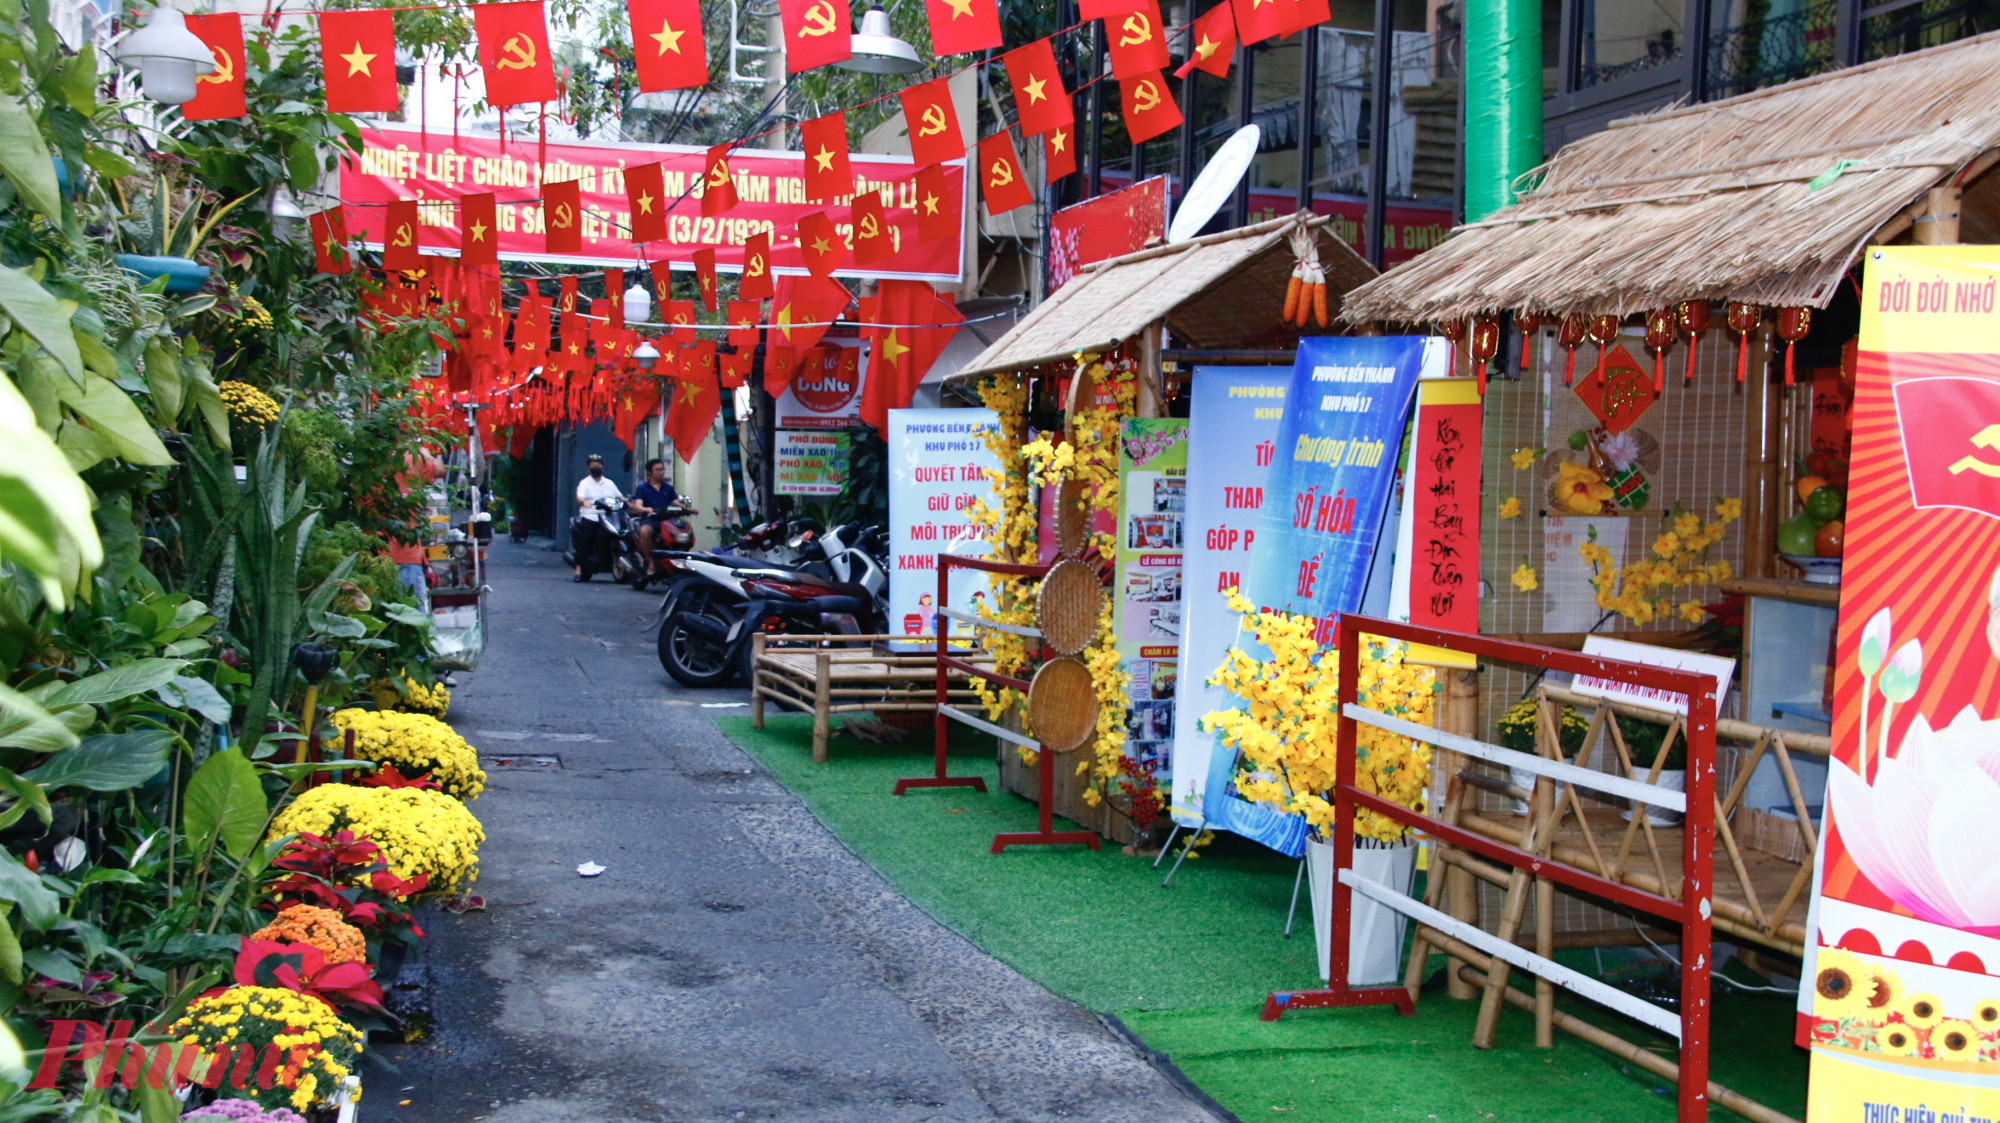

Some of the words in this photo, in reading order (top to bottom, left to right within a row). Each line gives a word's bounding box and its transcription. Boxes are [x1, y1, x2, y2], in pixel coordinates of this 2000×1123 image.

[360, 144, 420, 184] NHIỆT
[426, 148, 467, 188] LIỆT
[473, 153, 528, 187] CHÀO
[1879, 273, 1911, 313] ĐỜI
[1917, 273, 1949, 313] ĐỜI
[1954, 274, 1997, 314] NHỚ
[1229, 384, 1285, 399] PHƯỜNG
[1320, 395, 1341, 411] KHU
[1254, 407, 1284, 419] KHU
[906, 422, 945, 434] PHƯỜNG
[947, 420, 966, 434] BẾN
[925, 442, 946, 451] KHU
[948, 438, 967, 451] PHỐ
[1345, 435, 1384, 468] trình
[915, 464, 956, 482] QUYẾT
[928, 493, 950, 511] GIỮ
[1294, 485, 1320, 529] SỐ
[1315, 488, 1356, 535] HÓA
[911, 521, 937, 540] MÔI
[1206, 524, 1239, 551] GÓP
[1297, 553, 1324, 598] ĐỂ
